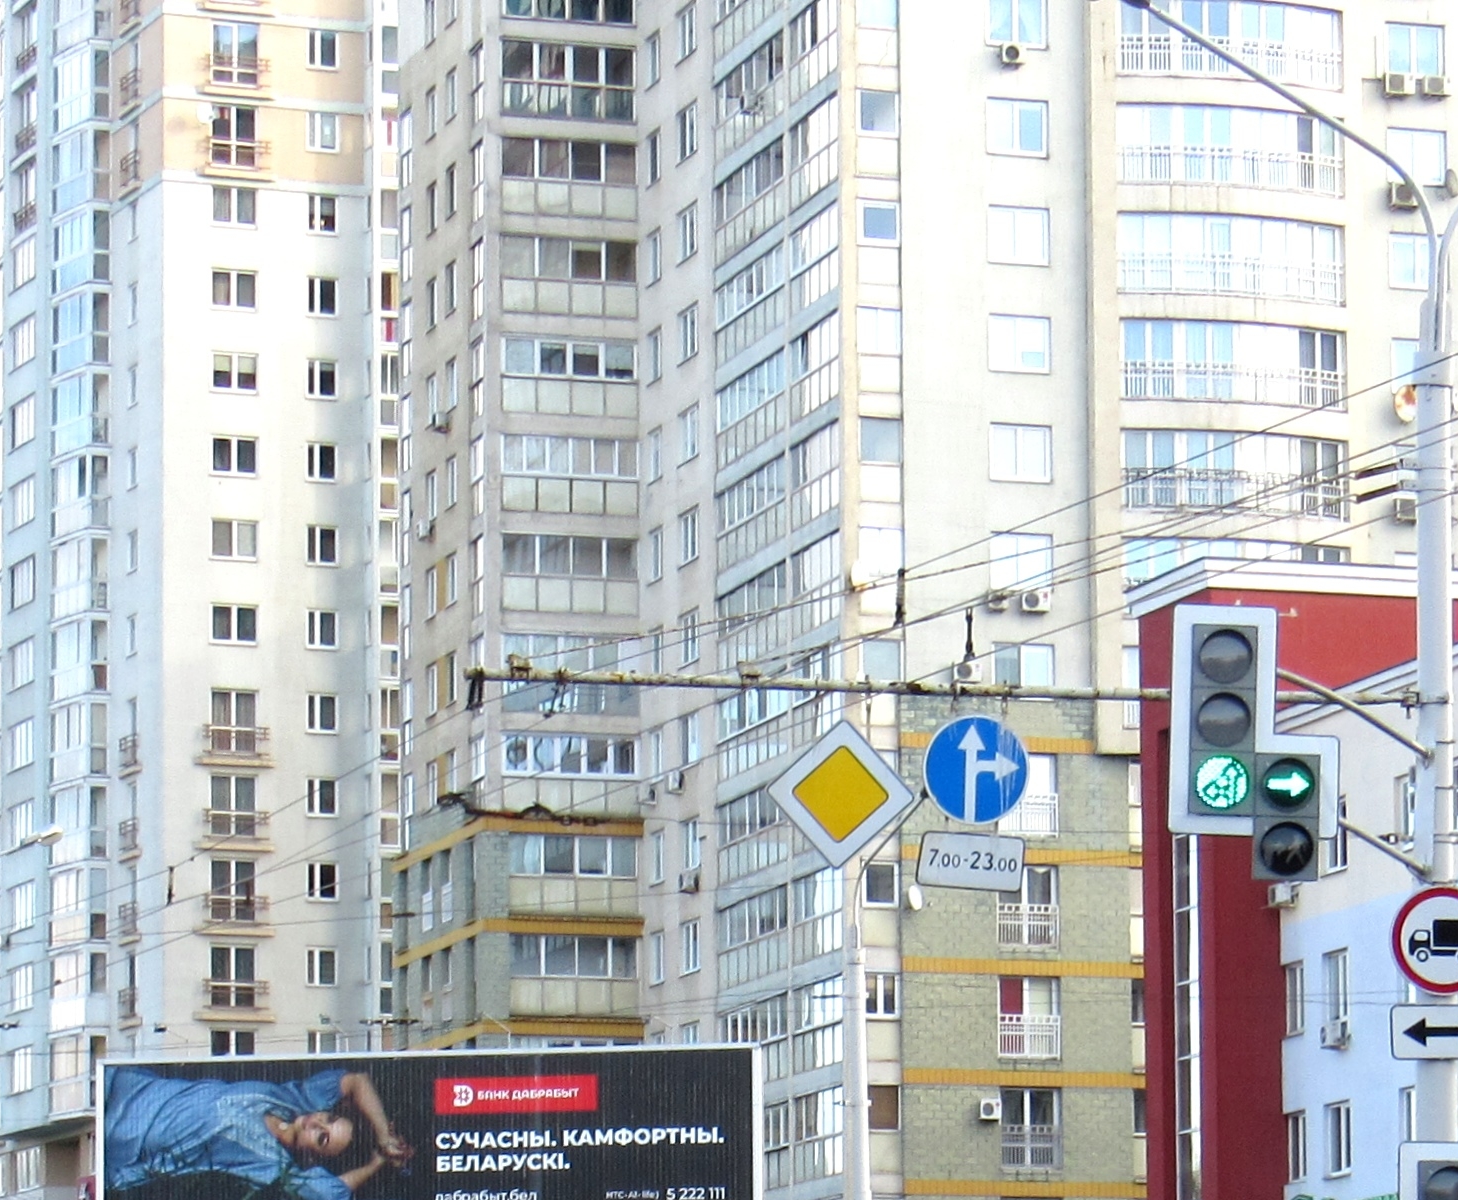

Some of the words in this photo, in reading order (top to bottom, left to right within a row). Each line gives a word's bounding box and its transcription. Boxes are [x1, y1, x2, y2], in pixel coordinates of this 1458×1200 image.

[512, 1087, 579, 1100] ДАБРАБЫТ
[435, 1130, 557, 1150] СУЧАСНЫ.
[563, 1126, 725, 1147] КАМФОРТНЫ.
[436, 1152, 571, 1172] БЕЛАРУСКІ.
[666, 1187, 676, 1200] 5
[679, 1187, 705, 1200] 222
[709, 1186, 726, 1200] 111
